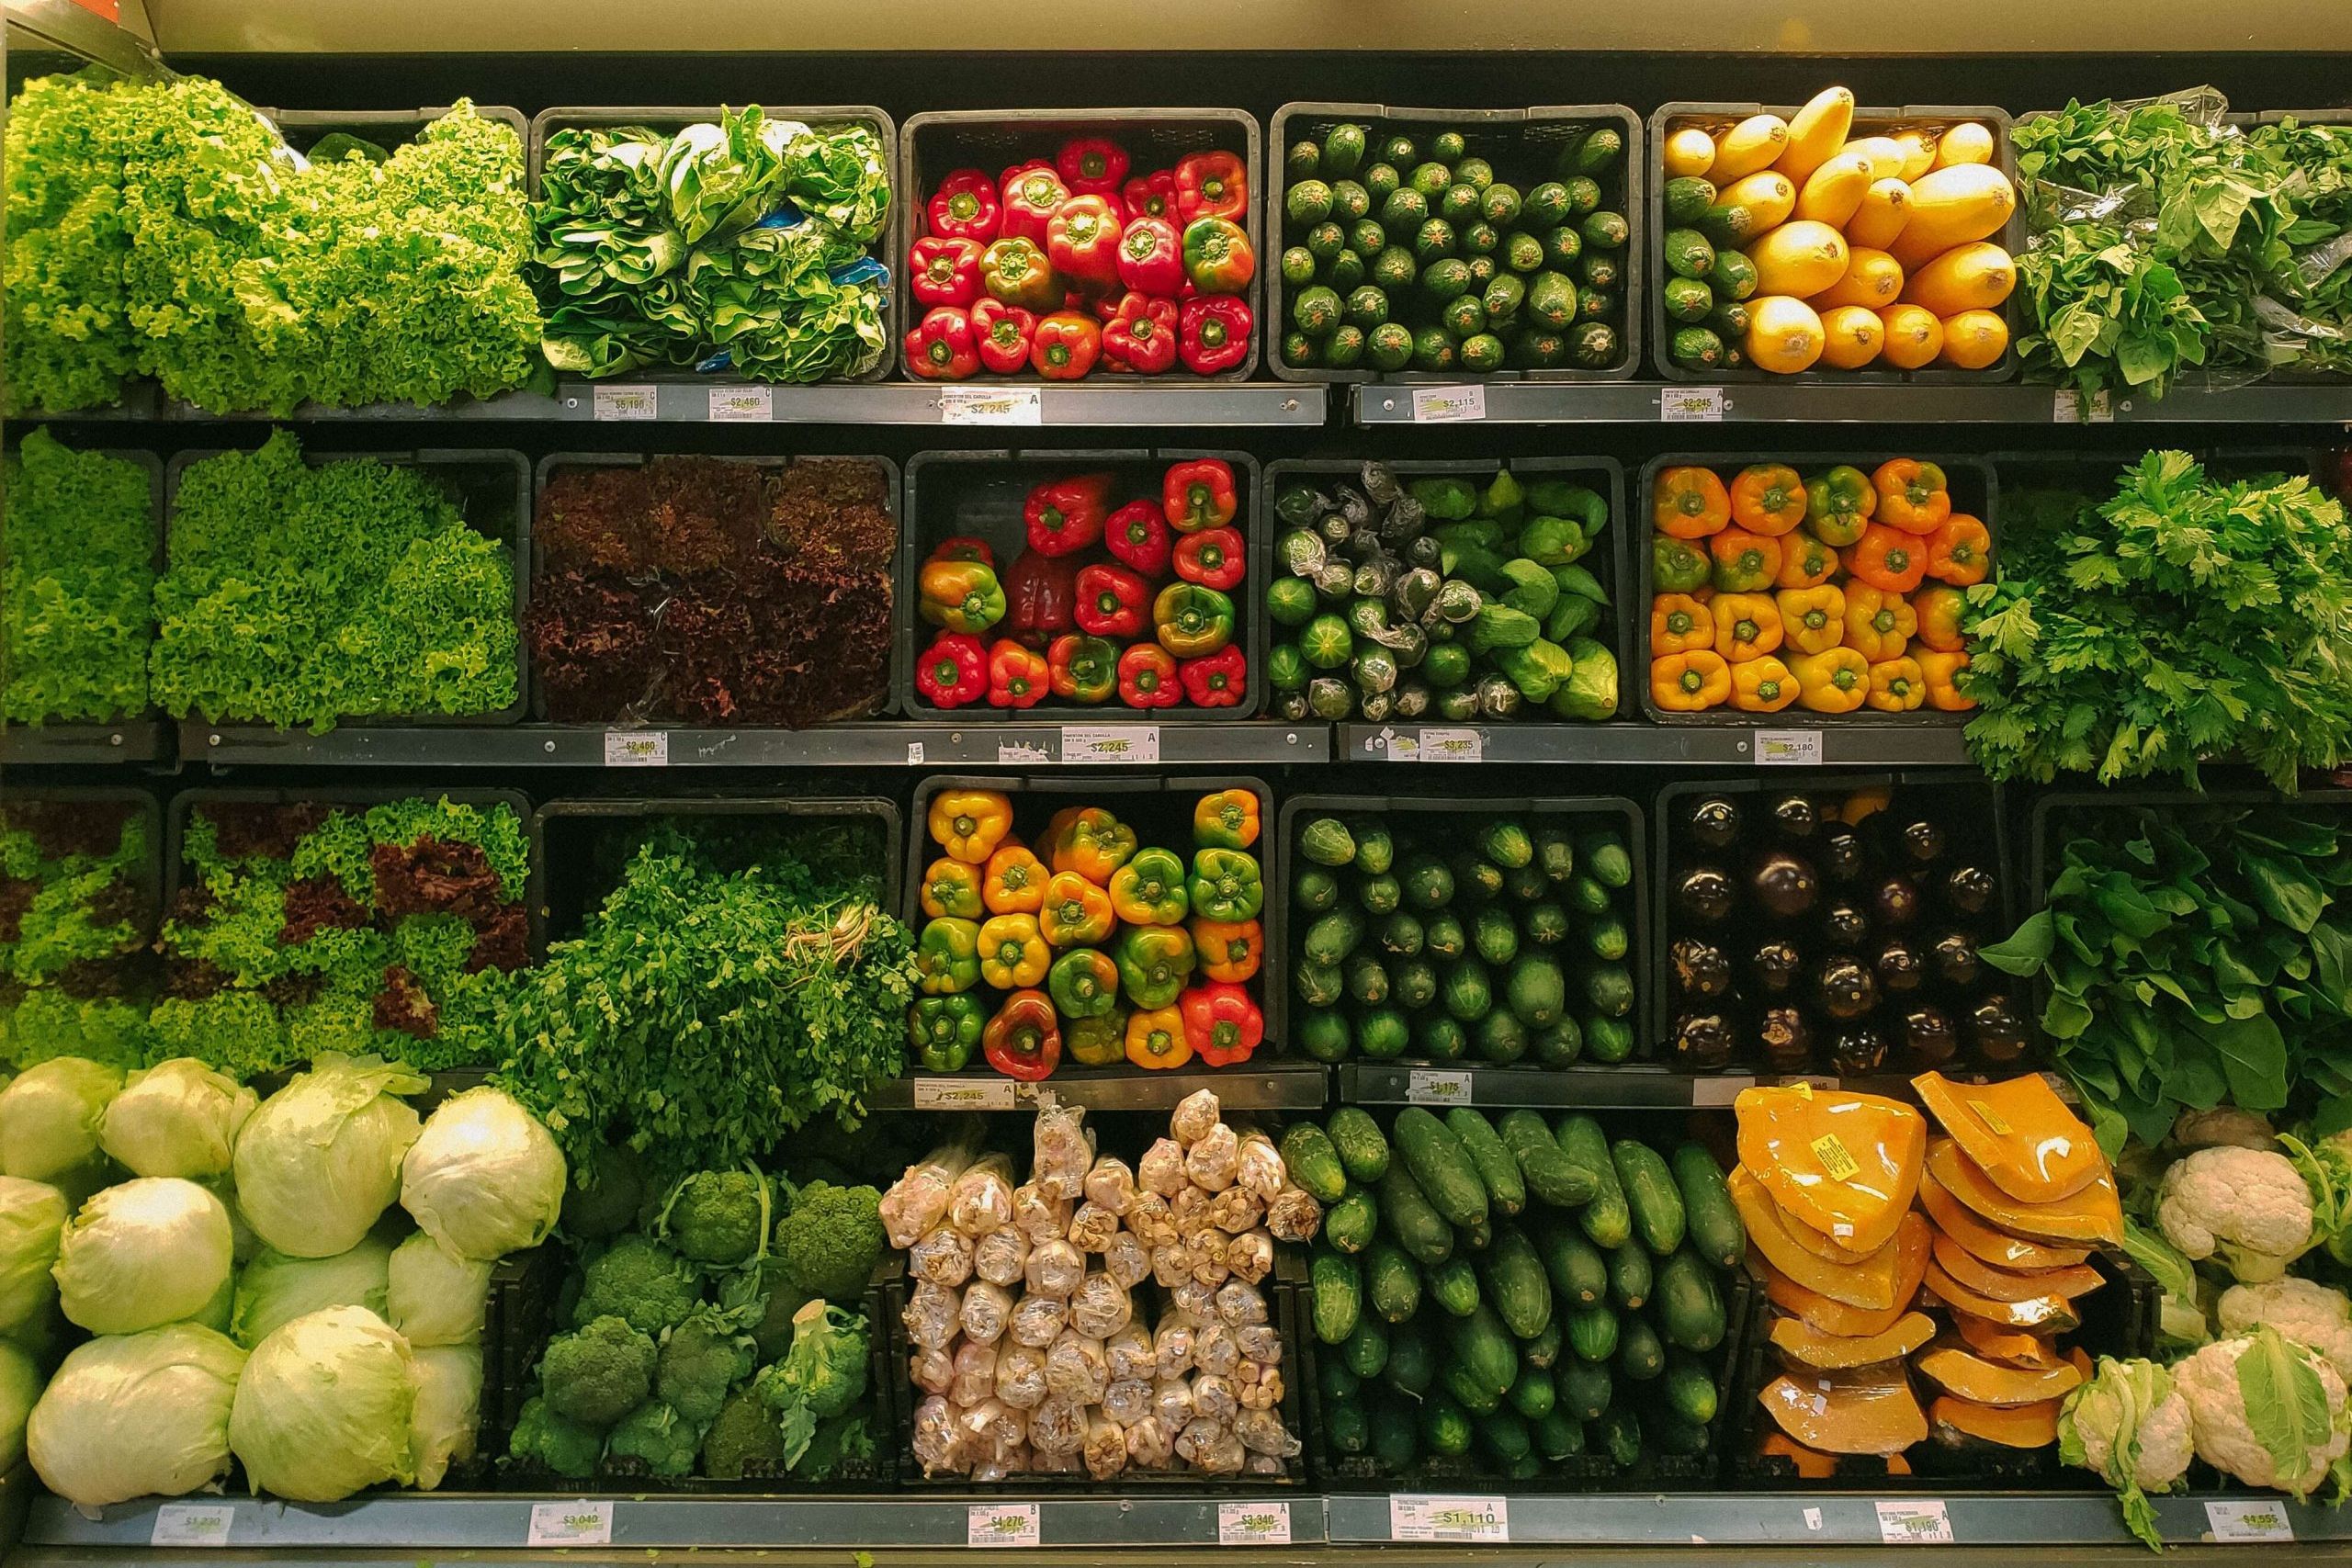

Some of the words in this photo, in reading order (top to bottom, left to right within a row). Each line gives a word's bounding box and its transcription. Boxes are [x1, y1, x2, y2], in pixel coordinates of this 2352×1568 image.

[730, 397, 760, 408] $2,460
[1030, 394, 1039, 405] A
[1443, 398, 1475, 408] $2,115
[1148, 732, 1156, 742] A
[626, 740, 655, 751] $2,460
[1091, 742, 1128, 753] $2,245
[1444, 739, 1474, 750] $3,235
[1782, 743, 1813, 753] $2,180
[1003, 1085, 1012, 1093] A
[944, 1091, 984, 1100] $2,245
[1487, 1503, 1493, 1511] A
[1242, 1515, 1274, 1526] $3,340
[1442, 1512, 1495, 1525] $1,110
